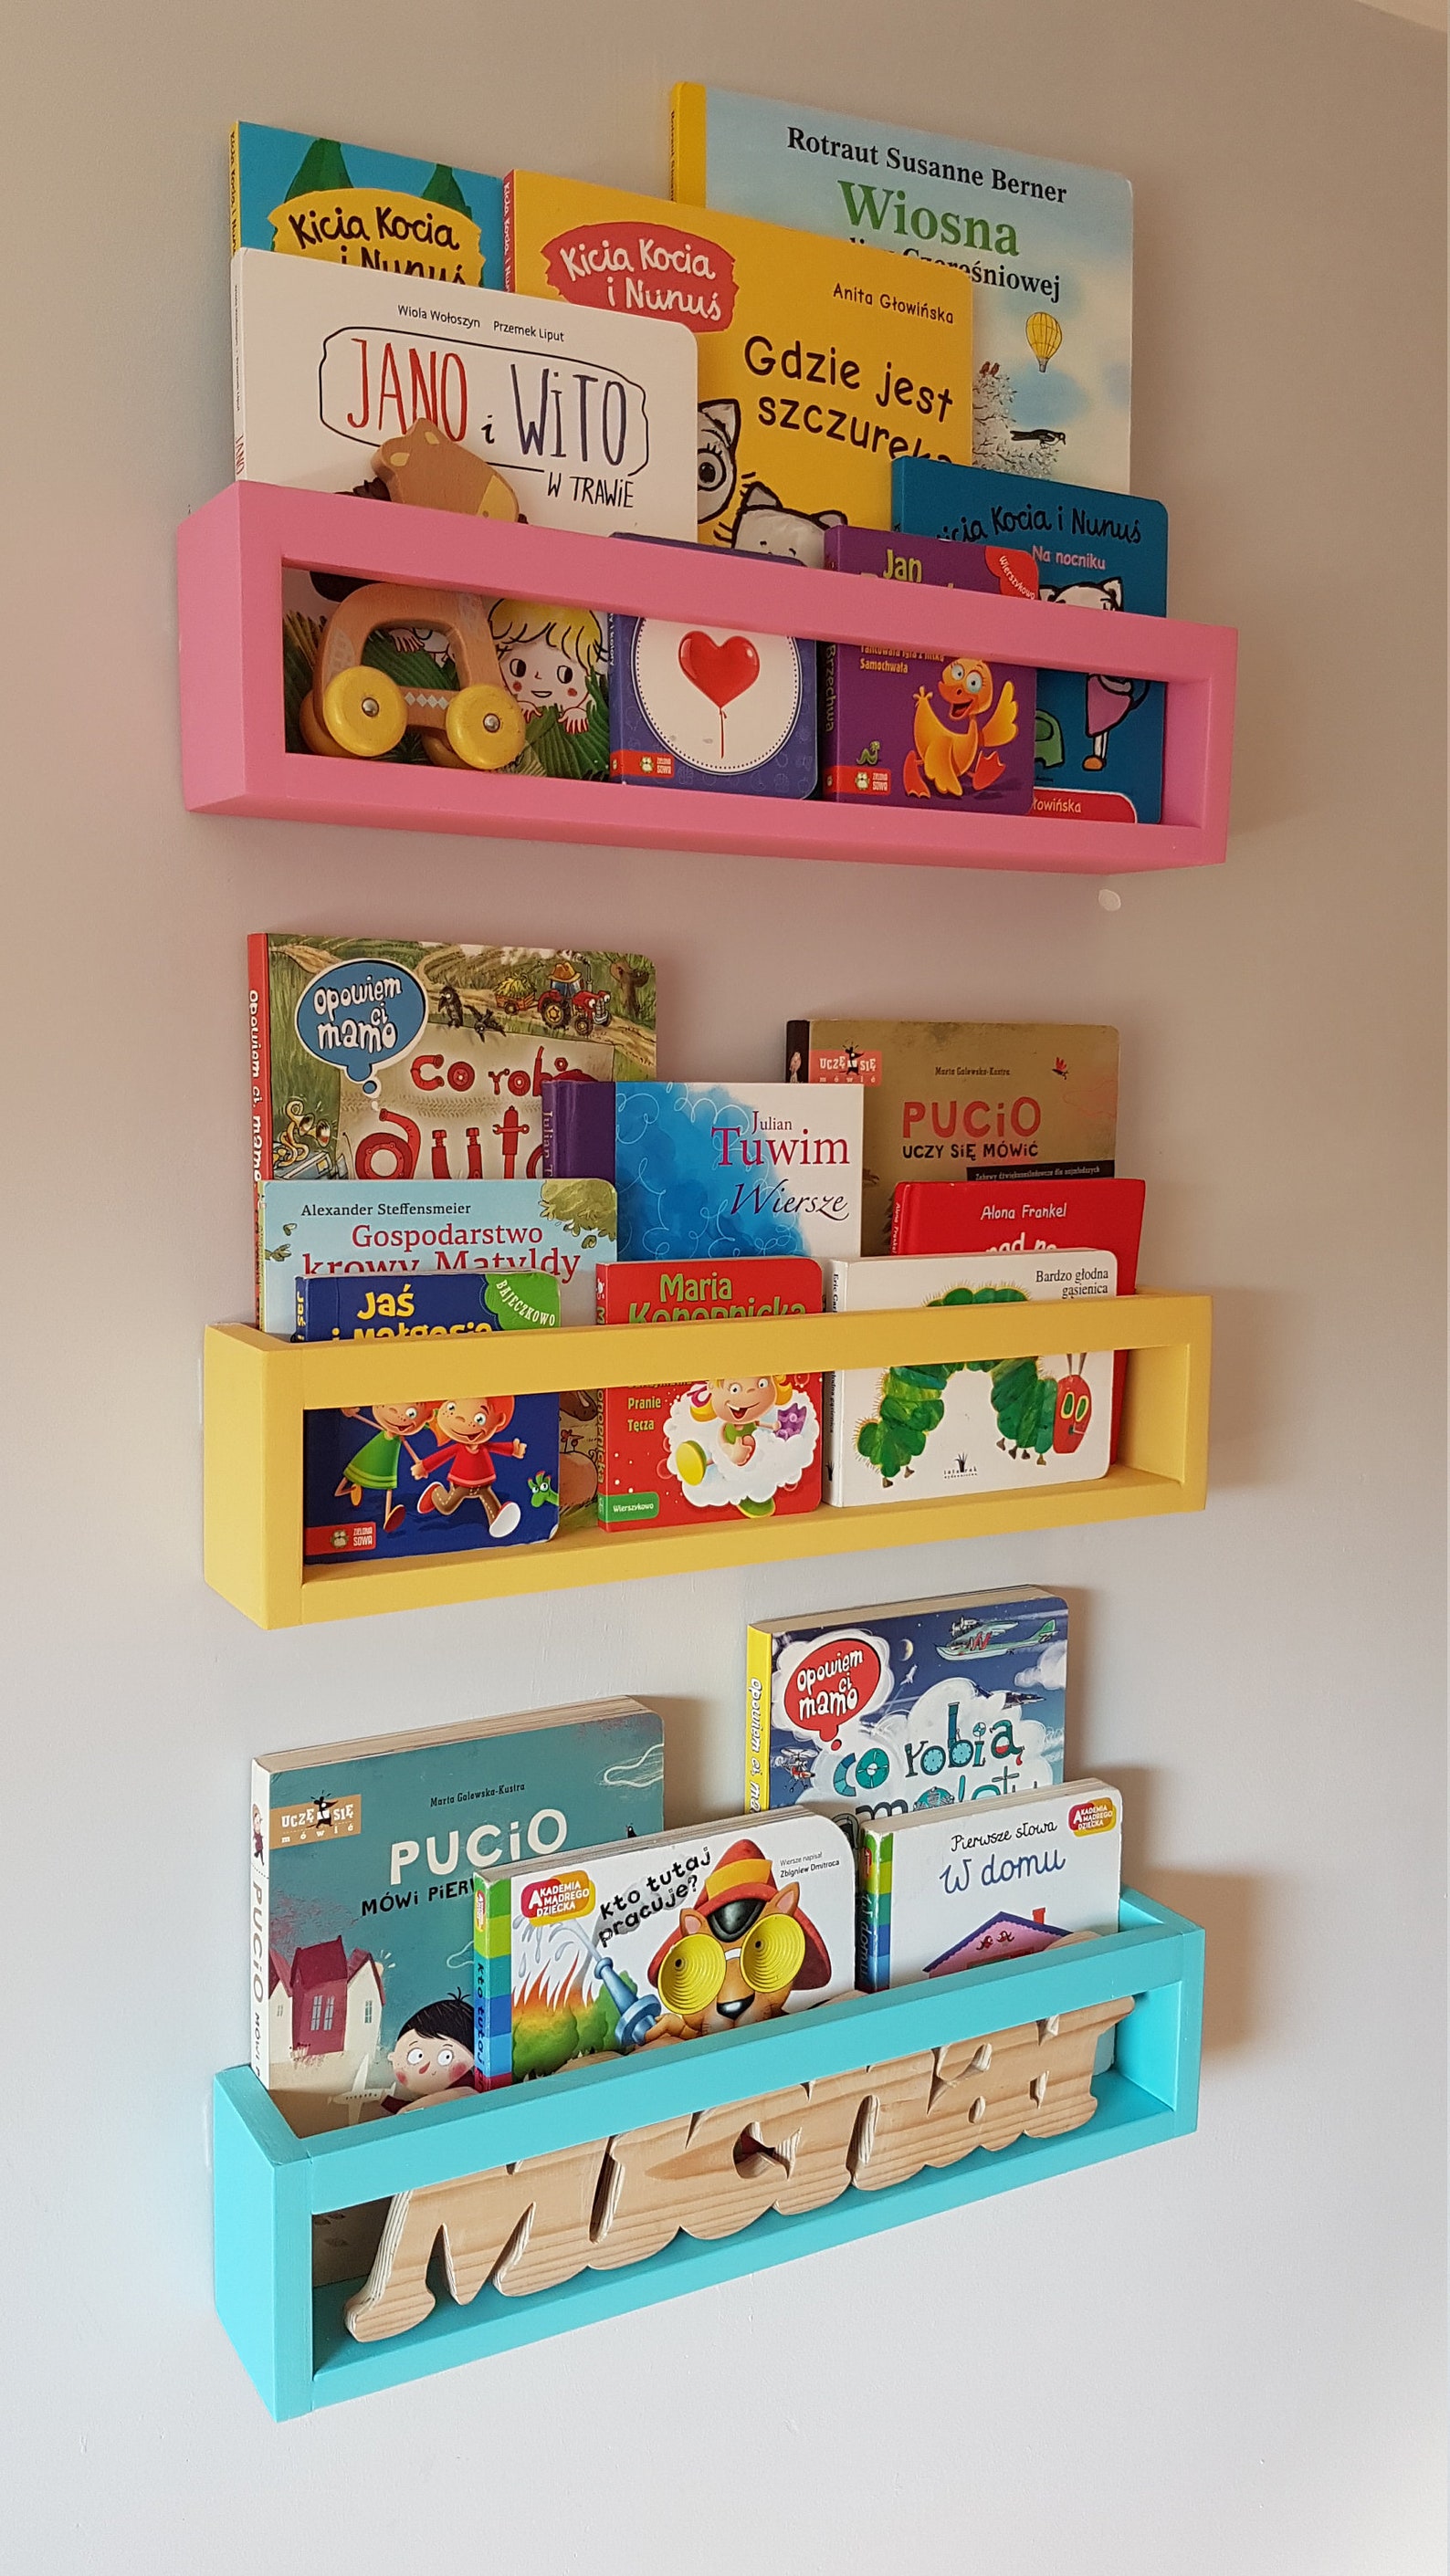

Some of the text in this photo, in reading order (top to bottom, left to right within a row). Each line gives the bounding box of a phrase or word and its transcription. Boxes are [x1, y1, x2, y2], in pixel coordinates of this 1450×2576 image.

[787, 126, 1066, 204] Rotraut Susanne Berner
[289, 206, 460, 250] Kicia Kocia
[837, 180, 1019, 257] Wiosna
[560, 238, 716, 282] Kicia Kocia
[607, 277, 721, 320] i Nunuś
[833, 282, 954, 324] Anita Głowińska
[397, 303, 564, 342] Wiola Wołoszyn Przemek Liput
[347, 338, 468, 443] JANO
[480, 414, 496, 444] i
[744, 336, 953, 423] Gdzie jest
[548, 472, 562, 498] W
[938, 504, 1141, 544] icia Kocia i Nunuś
[883, 549, 922, 583] Jan
[1033, 546, 1106, 571] Na nocniku
[999, 555, 1035, 600] Wierszykowo
[825, 644, 836, 732] Brzechwa
[1033, 798, 1082, 813] łowińska
[371, 1001, 387, 1027] ci
[318, 1019, 398, 1053] mamo
[819, 1056, 876, 1072] UCZĘ SIĘ
[543, 1111, 553, 1158] Julian
[751, 1110, 793, 1136] Julian
[711, 1127, 850, 1167] Tuwim
[903, 1145, 944, 1158] UCZY
[301, 1201, 471, 1217] Alexander Steffensmeier
[730, 1178, 850, 1221] Wiersze
[980, 1202, 1067, 1220] Alona Frankel
[352, 1221, 543, 1251] Gospodarstwo
[660, 1272, 732, 1303] Maria
[1035, 1268, 1109, 1283] Bardzo głodna
[1062, 1283, 1109, 1300] gąsienica
[297, 1291, 306, 1327] Jaś
[357, 1283, 415, 1320] Jaś
[496, 1279, 555, 1326] BAJECZKOWO
[627, 1397, 661, 1410] Pranie
[627, 1419, 655, 1432] Tęcza
[613, 1502, 654, 1513] Wierszykowo
[353, 1535, 373, 1546] SOWA
[839, 1672, 852, 1694] ci
[799, 1690, 858, 1721] mamo
[904, 1702, 1025, 1779] robią
[281, 1804, 354, 1827] UCZĘ SIĘ
[430, 1795, 455, 1807] Marta
[951, 1819, 1057, 1852] Pierwsze słowa
[646, 1847, 710, 1891] tutaj
[780, 1867, 809, 1878] Zbigniew
[981, 1848, 1066, 1886] domu
[529, 1880, 582, 1910] AKADEMIA
[537, 1901, 575, 1918] DZIECKA
[544, 1888, 590, 1906] MĄDREGO
[599, 1875, 698, 1948] pracuje?
[477, 2006, 486, 2066] tutaj
